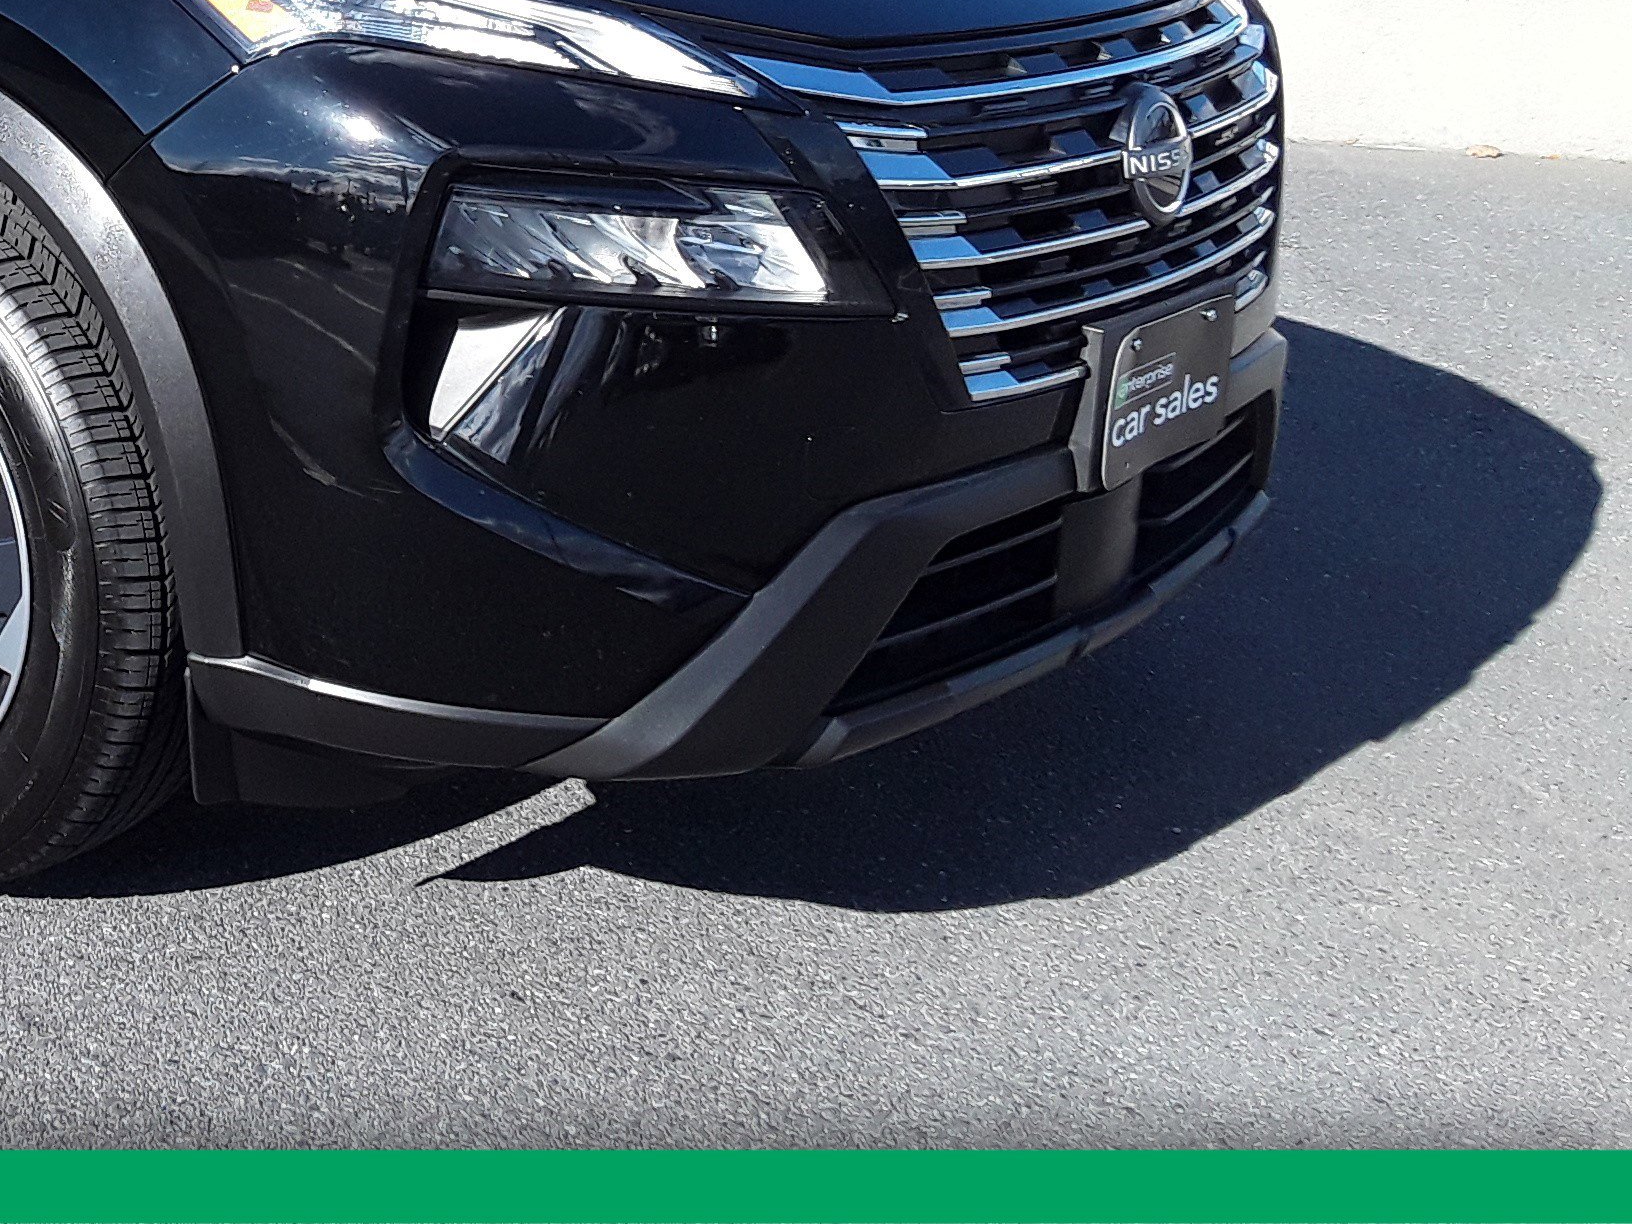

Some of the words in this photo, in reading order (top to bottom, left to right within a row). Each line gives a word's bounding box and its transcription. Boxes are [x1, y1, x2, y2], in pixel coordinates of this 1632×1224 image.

[1129, 147, 1189, 175] NISS
[1112, 404, 1152, 447] car
[1153, 373, 1220, 426] sales
